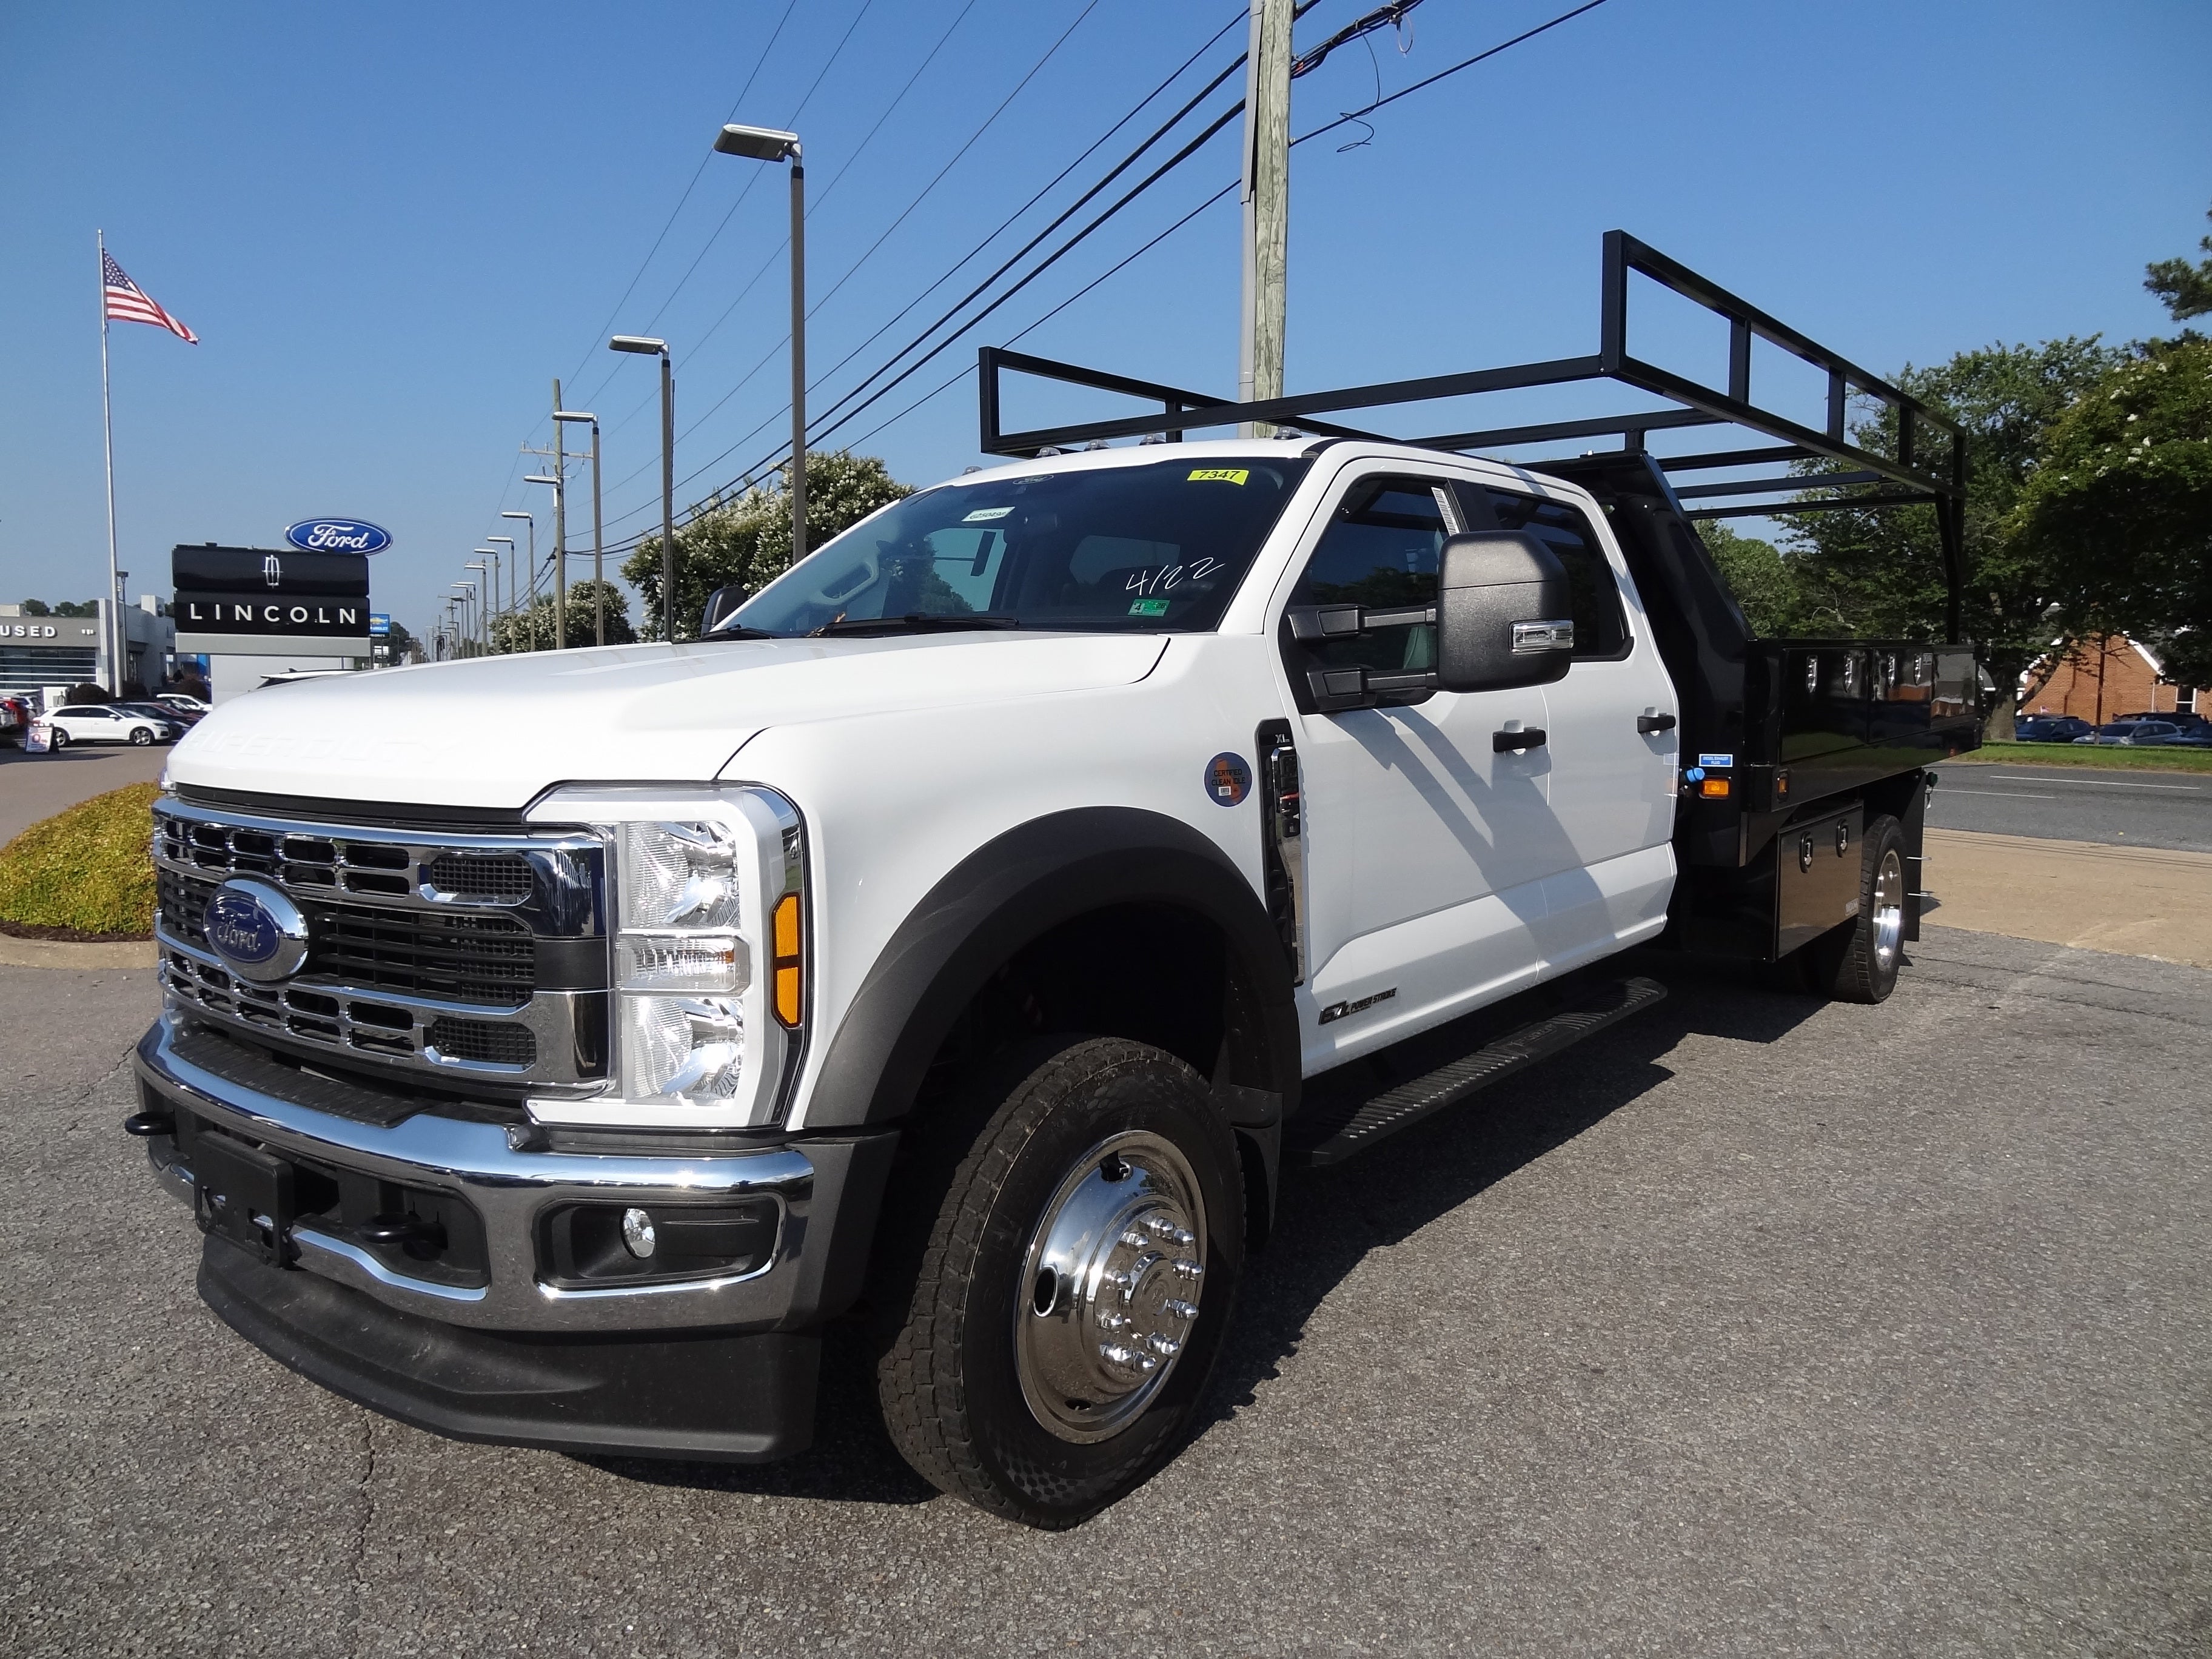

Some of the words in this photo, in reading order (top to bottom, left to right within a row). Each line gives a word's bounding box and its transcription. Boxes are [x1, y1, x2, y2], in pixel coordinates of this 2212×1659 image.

[1199, 471, 1240, 479] 7347
[308, 524, 369, 548] Ford
[190, 603, 356, 624] LINCOLN
[0, 625, 56, 637] USED
[1275, 734, 1290, 743] XL
[216, 907, 263, 953] Ford
